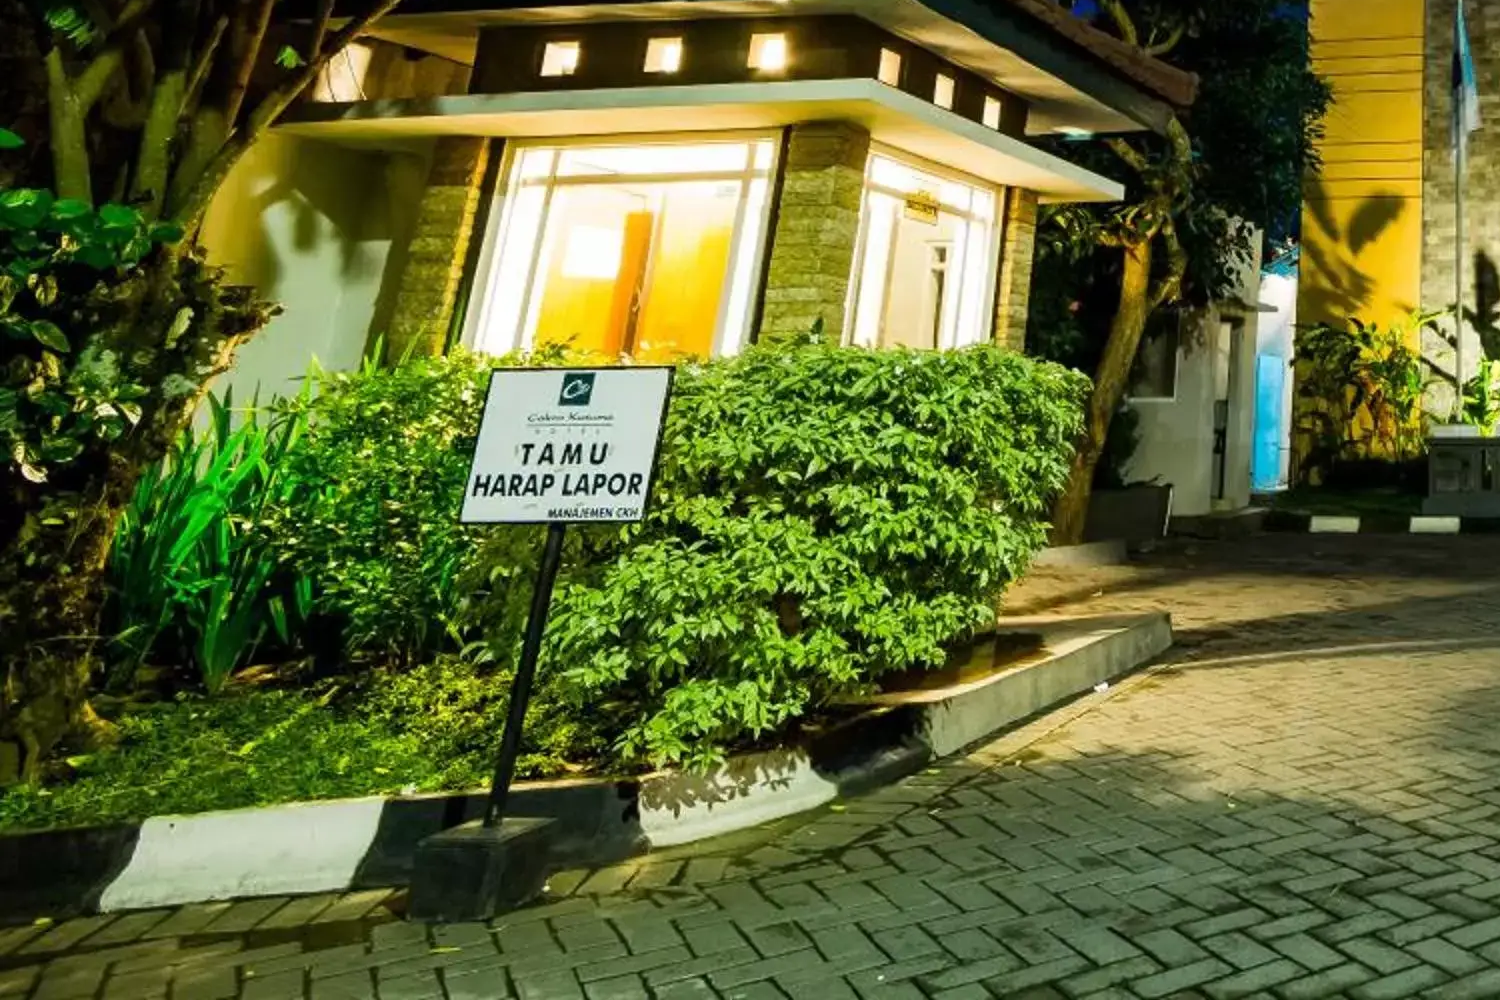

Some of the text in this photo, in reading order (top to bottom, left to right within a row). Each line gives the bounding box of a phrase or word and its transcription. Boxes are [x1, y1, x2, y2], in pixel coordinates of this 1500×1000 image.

[521, 442, 609, 466] TAMU
[472, 472, 643, 497] HARAP LAPOR
[547, 507, 613, 518] MANAJEMEN
